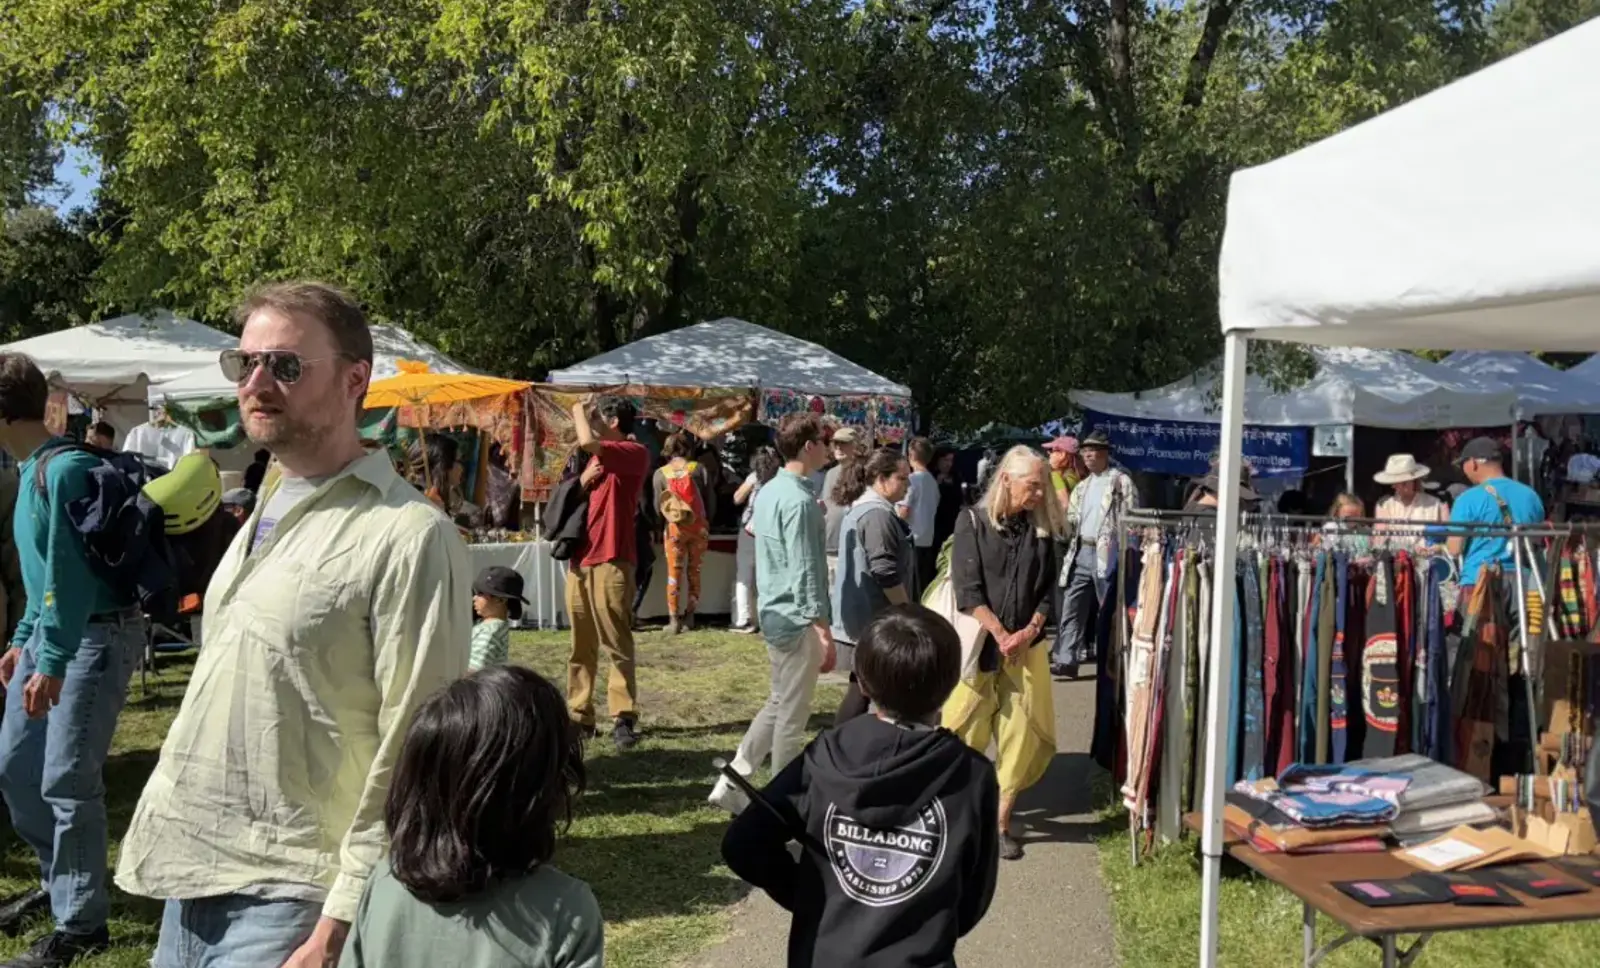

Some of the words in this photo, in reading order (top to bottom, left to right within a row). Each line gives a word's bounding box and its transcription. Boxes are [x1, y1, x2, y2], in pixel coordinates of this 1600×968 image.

[1117, 445, 1145, 456] Health
[1147, 446, 1192, 460] Promotion
[1240, 453, 1292, 466] ommittee
[836, 823, 933, 852] BILLABONG
[836, 849, 897, 895] ESTABLISHED
